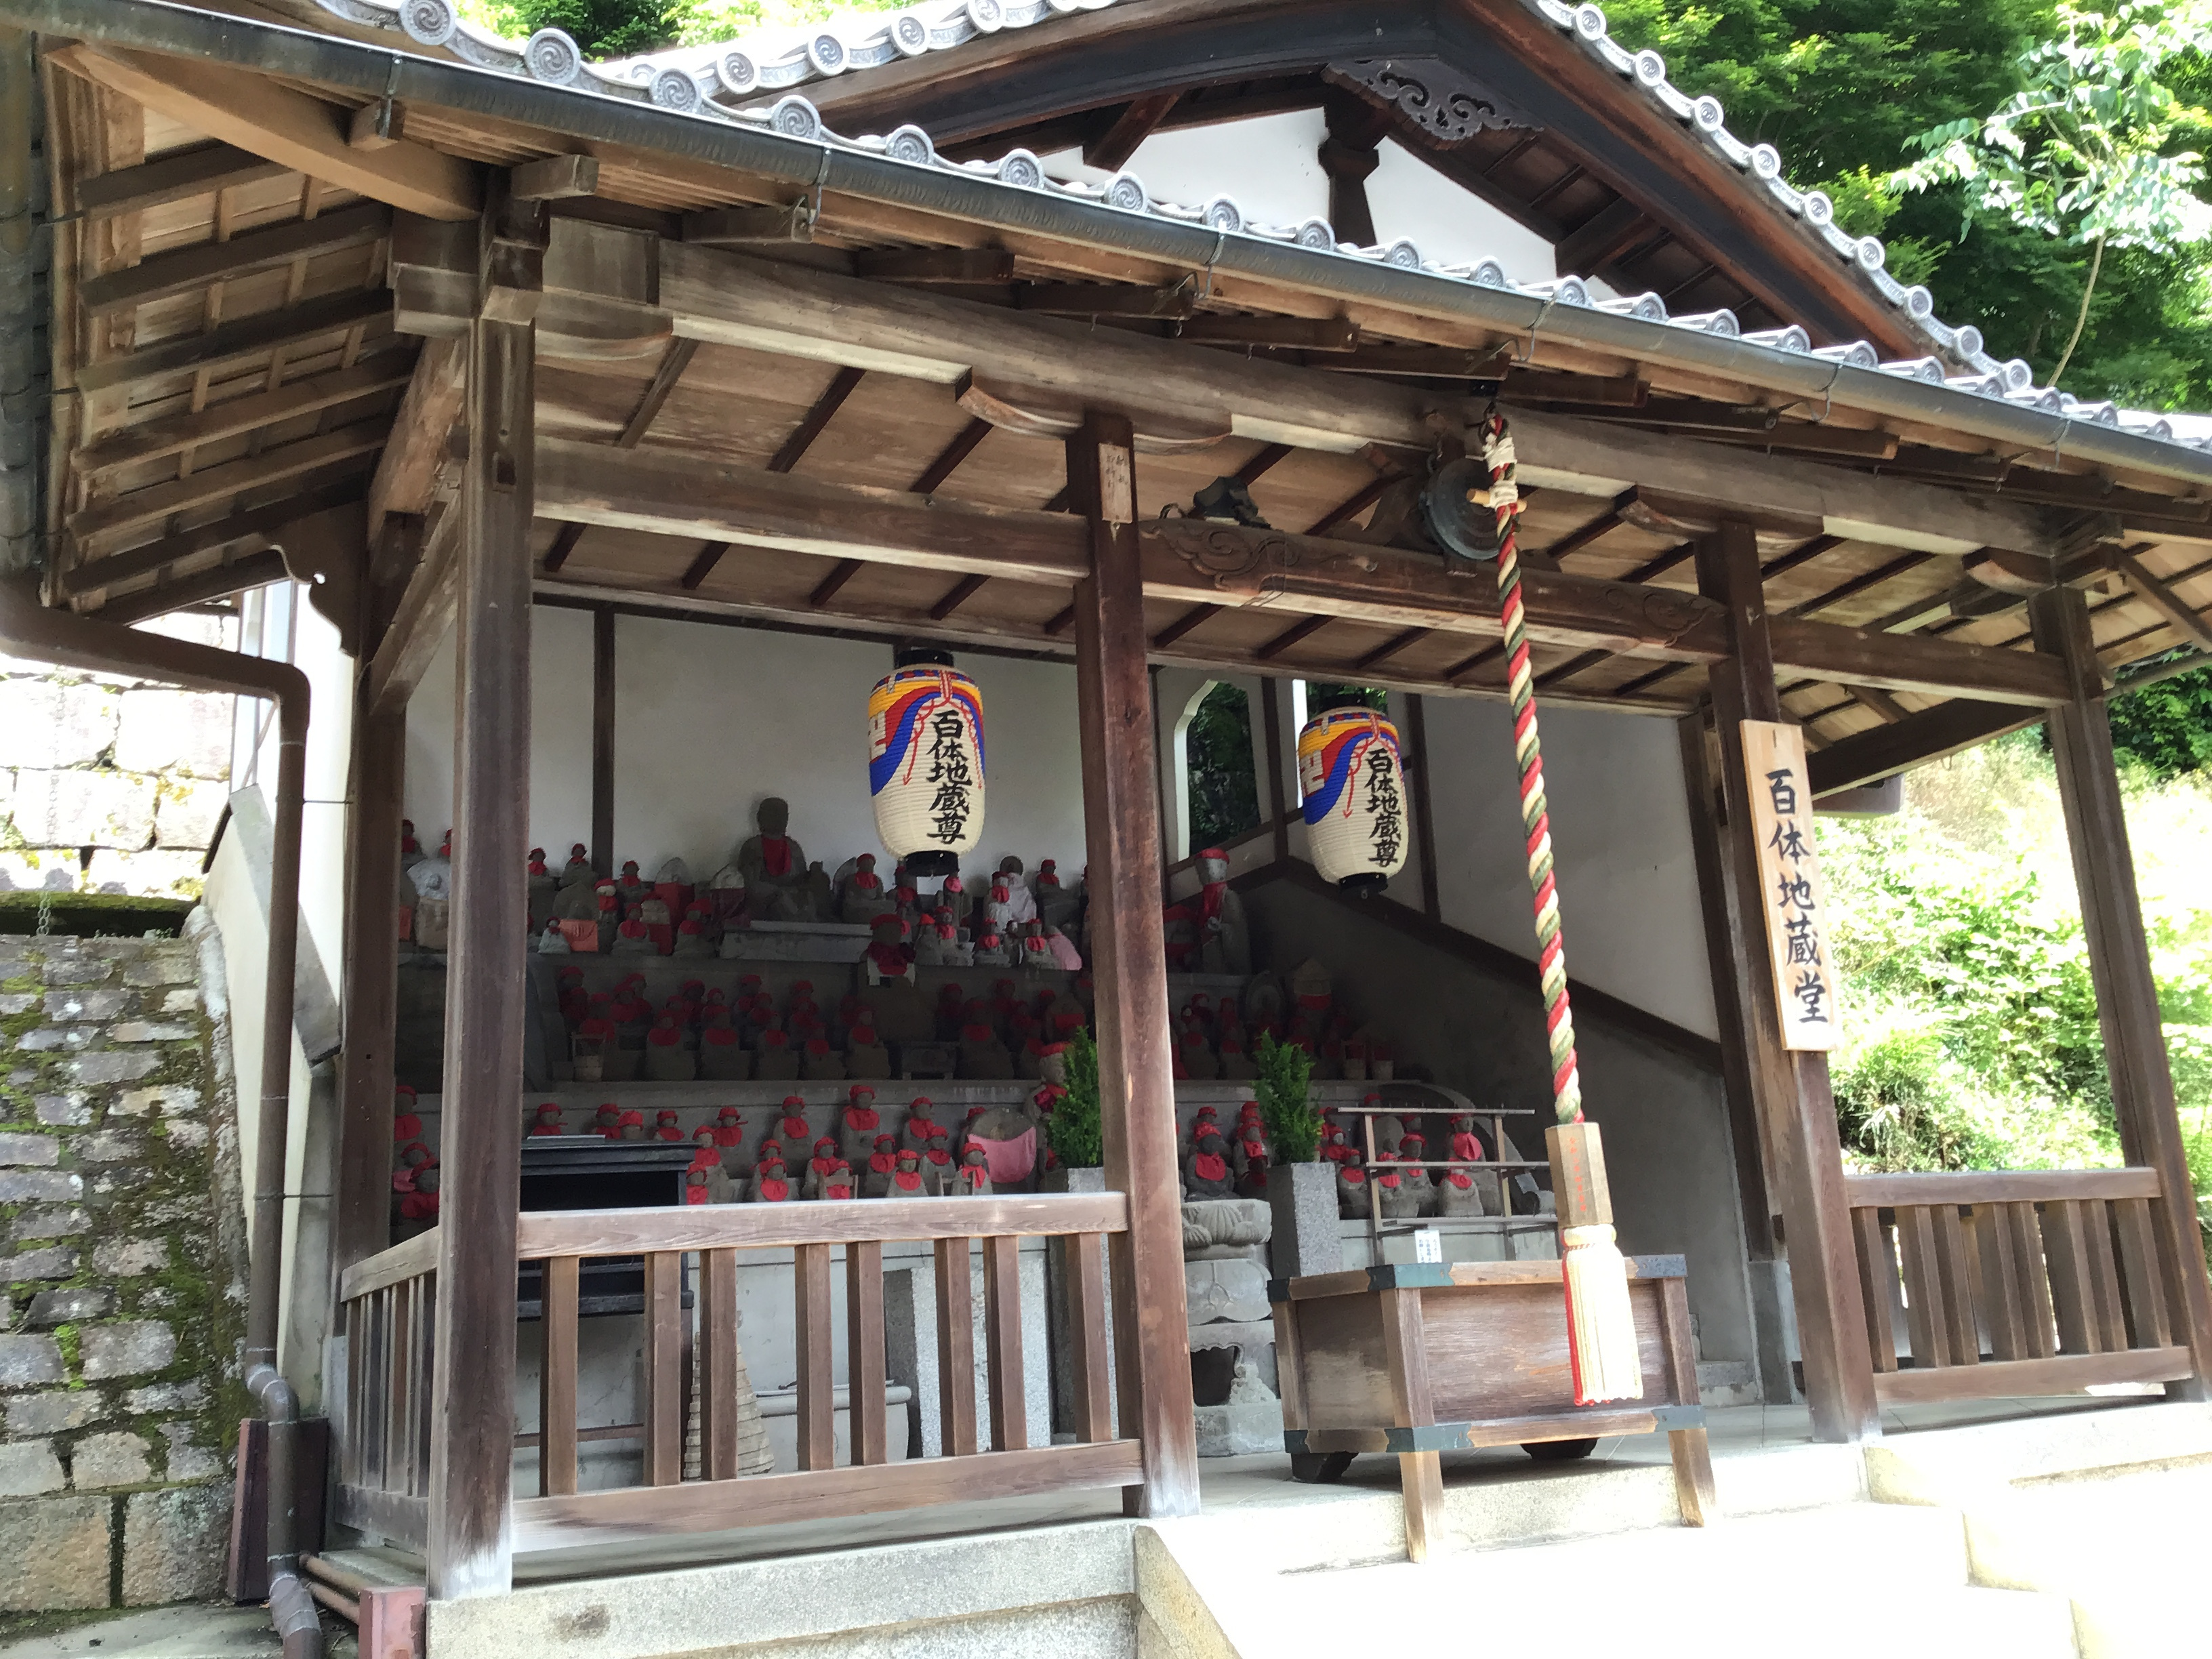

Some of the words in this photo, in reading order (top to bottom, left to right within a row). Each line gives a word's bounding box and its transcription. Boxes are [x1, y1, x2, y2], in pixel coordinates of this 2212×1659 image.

[926, 709, 972, 845] 百体地蔵尊
[1364, 747, 1401, 868] 百体地蔵尊
[1765, 768, 1829, 1024] 百体地蔵堂
